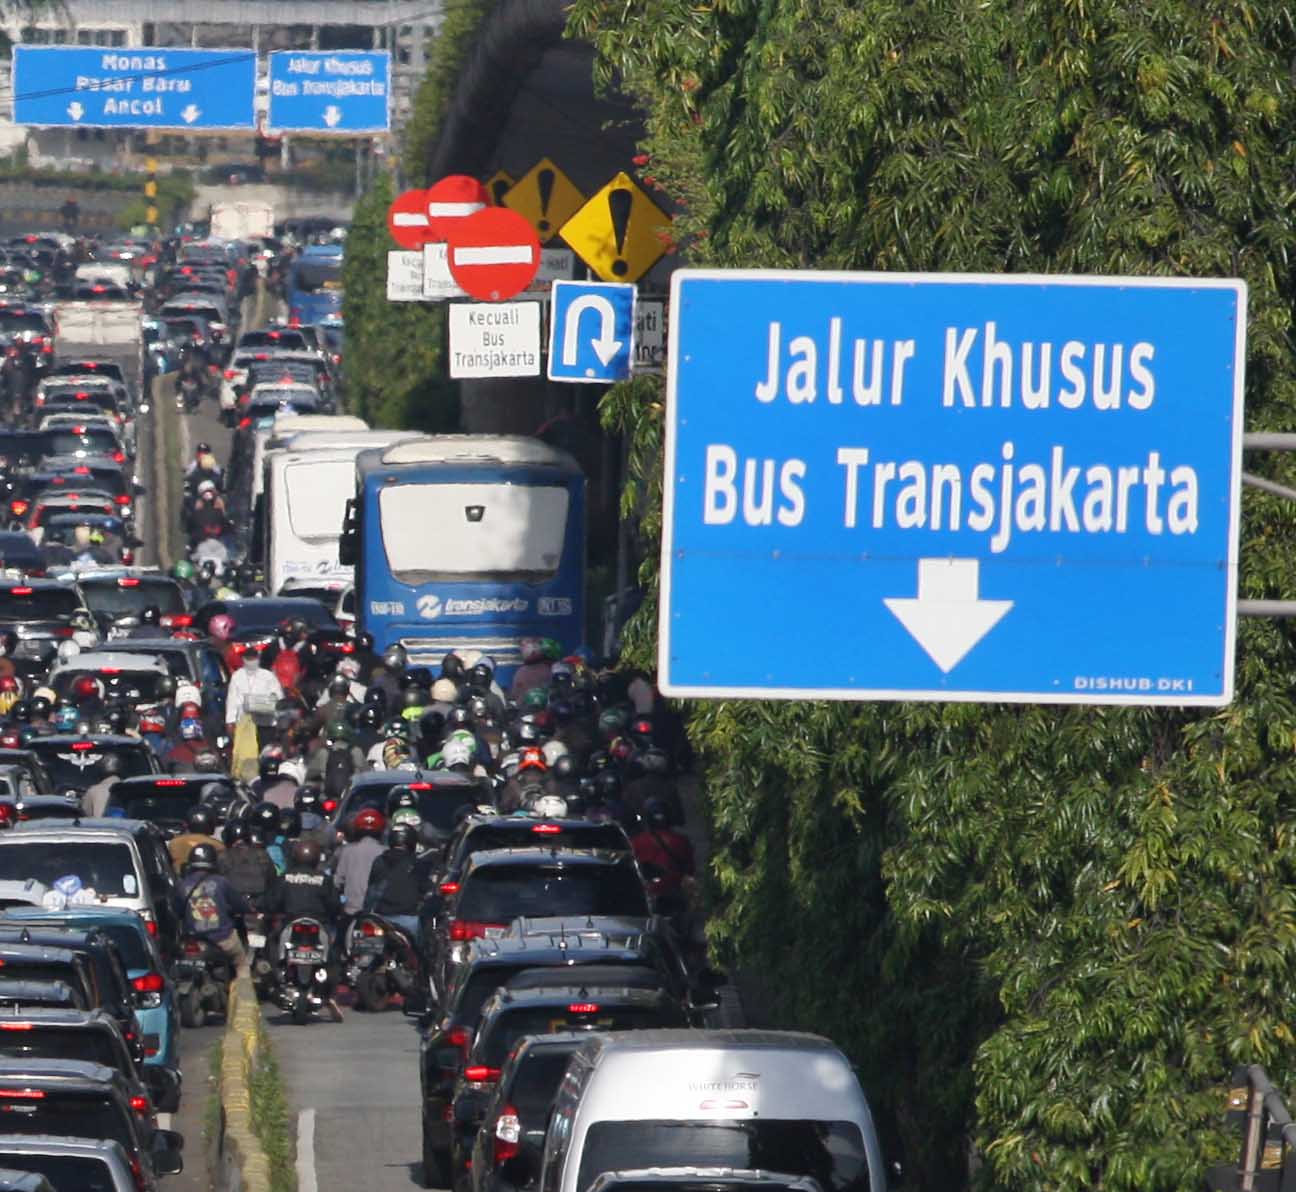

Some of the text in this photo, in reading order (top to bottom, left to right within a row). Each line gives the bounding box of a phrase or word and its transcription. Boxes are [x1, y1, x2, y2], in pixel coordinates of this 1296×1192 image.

[101, 55, 167, 71] Monas
[75, 76, 192, 92] Pasar Baru
[103, 98, 164, 115] Ancol
[468, 308, 519, 326] Kecuali
[482, 331, 505, 347] Bus
[455, 350, 535, 370] Transjakarta
[755, 317, 1157, 412] Jalur Khusus
[703, 441, 1199, 554] Bus Transjakarta
[1074, 676, 1193, 691] DISHUB DKI
